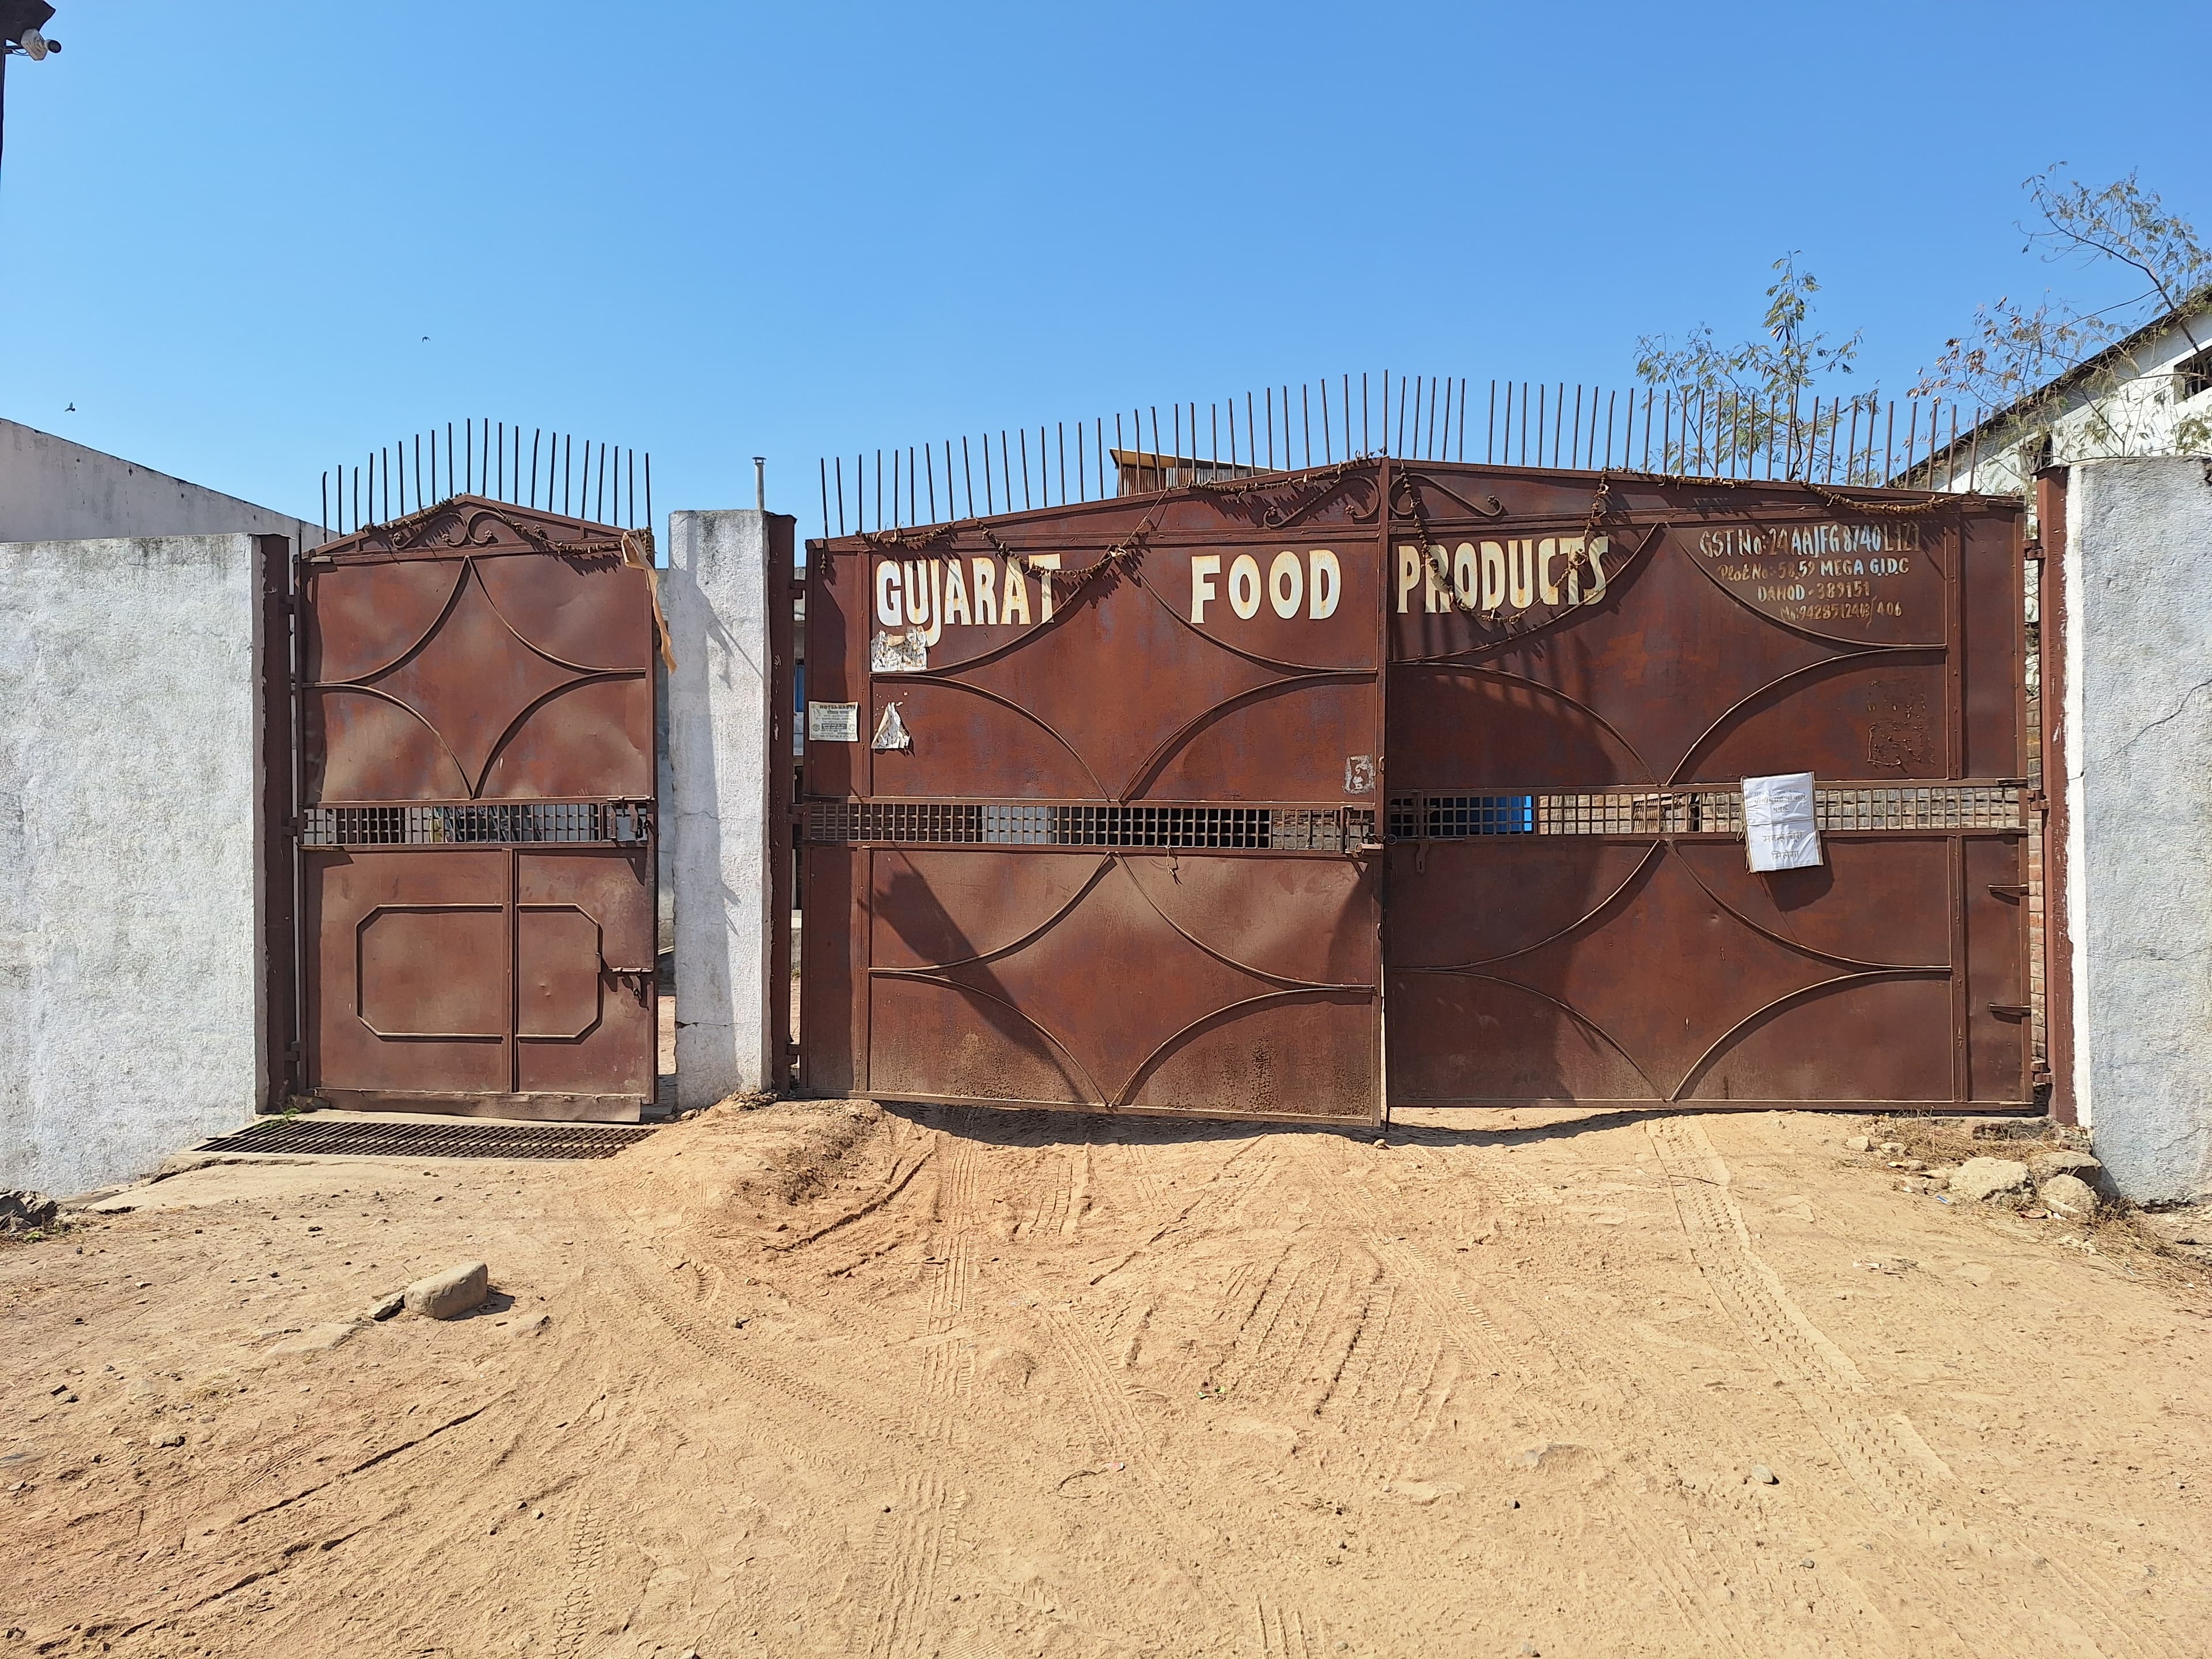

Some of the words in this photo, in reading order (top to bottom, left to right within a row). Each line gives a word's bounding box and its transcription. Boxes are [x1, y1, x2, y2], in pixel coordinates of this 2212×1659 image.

[1699, 528, 1734, 558] GST
[1717, 563, 1750, 582] Plot
[1820, 559, 1865, 577] MEGA
[876, 553, 1061, 647] GUJARAT
[1191, 550, 1341, 624] FOOD
[1396, 536, 1609, 614] PRODUCTS
[1758, 584, 1805, 602] DAHOD
[1816, 580, 1870, 600] 389151
[1771, 849, 1801, 861] मिलेगा
